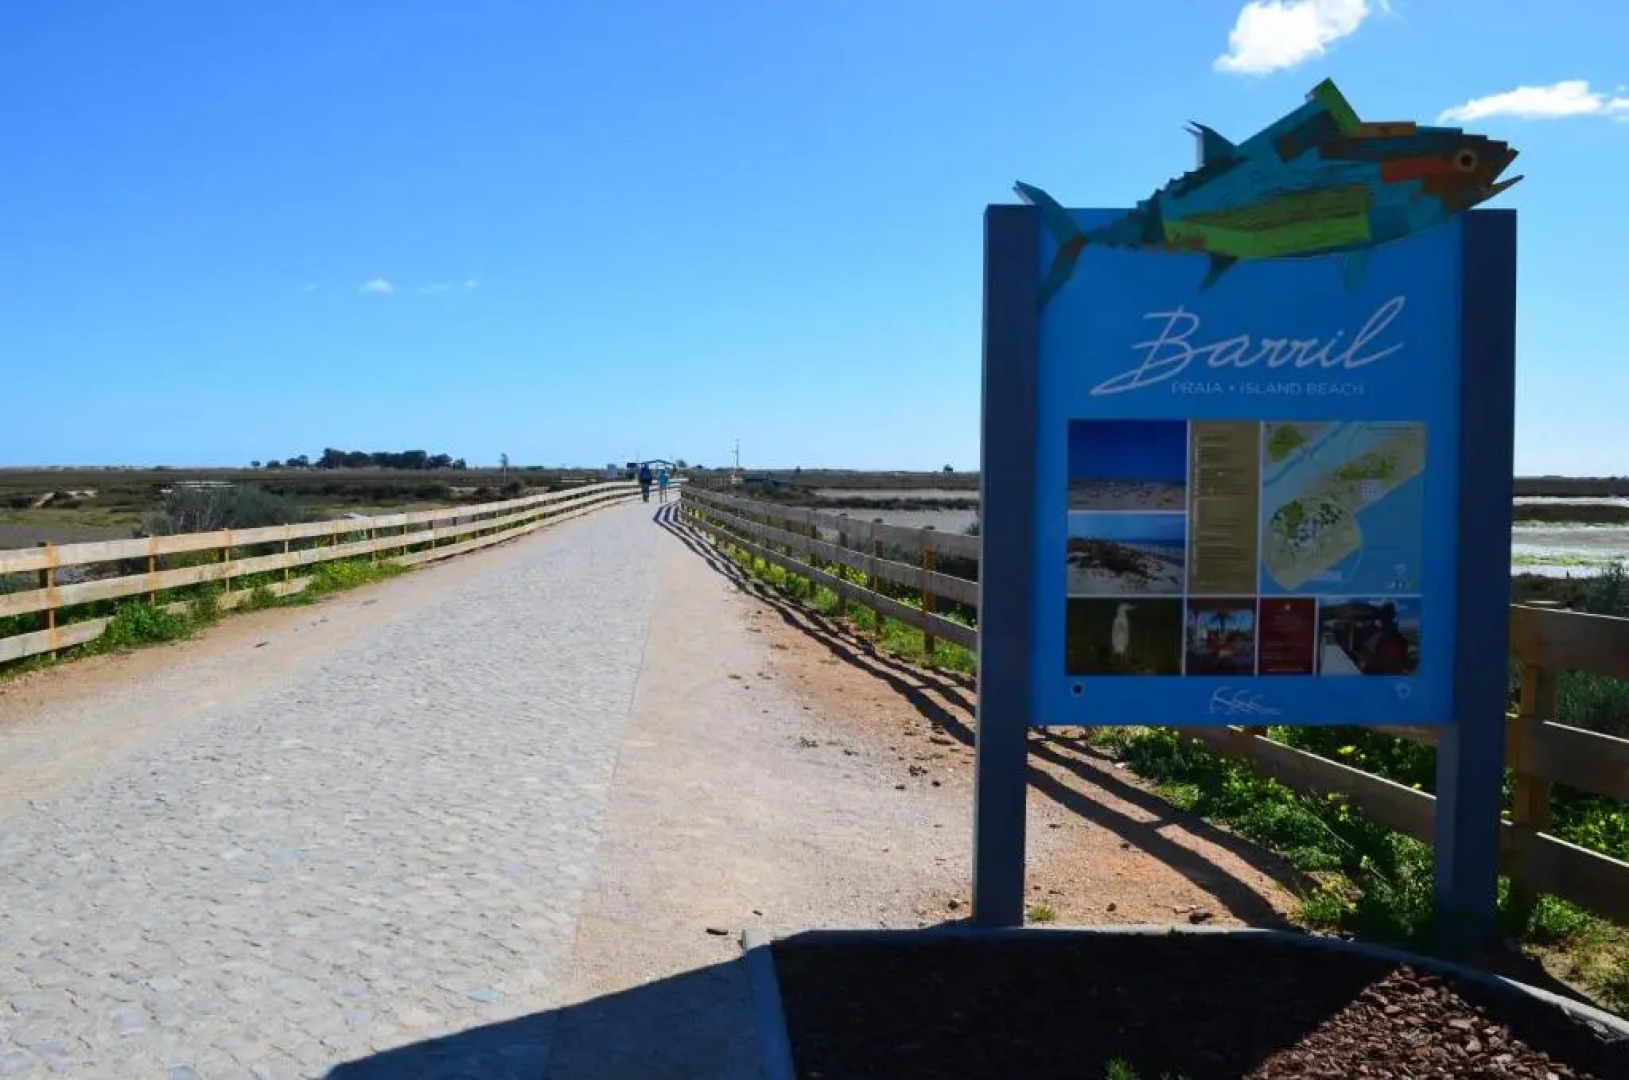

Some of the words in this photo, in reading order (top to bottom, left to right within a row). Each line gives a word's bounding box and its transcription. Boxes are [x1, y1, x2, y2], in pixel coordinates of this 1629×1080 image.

[1090, 295, 1406, 397] Barril
[1171, 382, 1223, 395] PRAIA
[1240, 382, 1303, 395] ISLAND
[1306, 382, 1365, 396] BEACH
